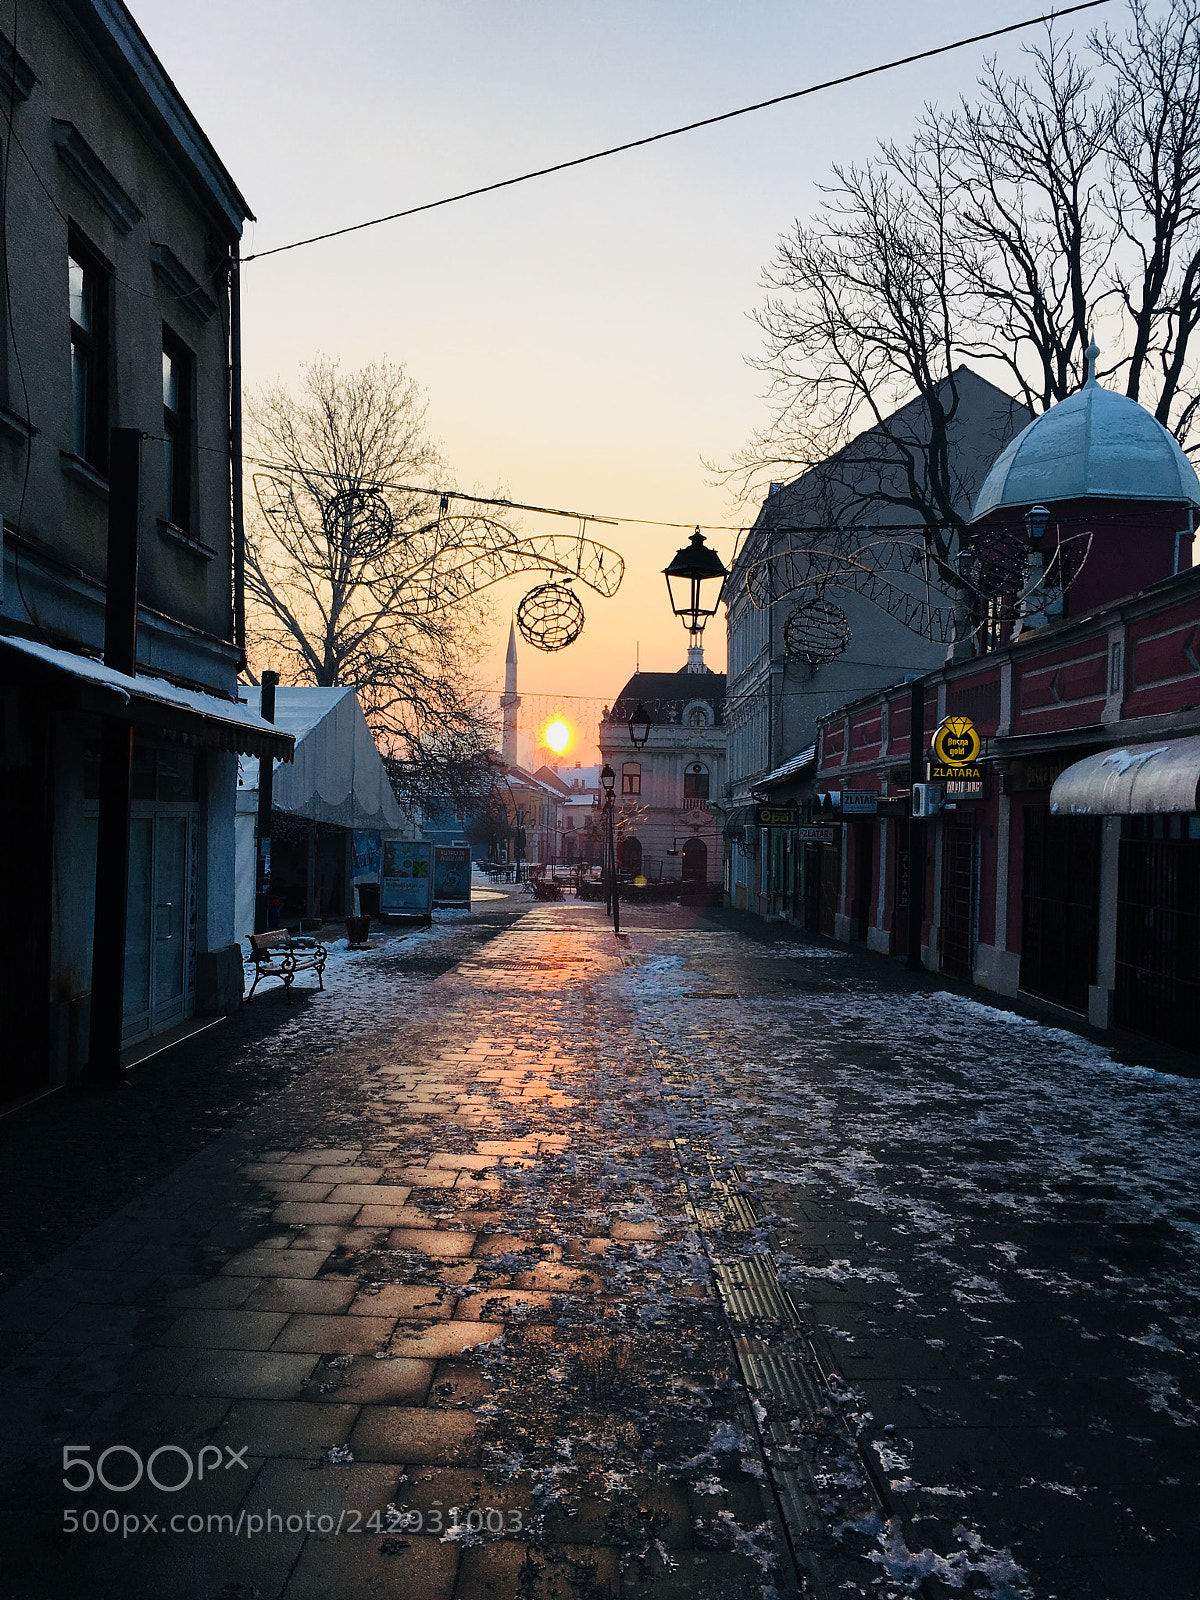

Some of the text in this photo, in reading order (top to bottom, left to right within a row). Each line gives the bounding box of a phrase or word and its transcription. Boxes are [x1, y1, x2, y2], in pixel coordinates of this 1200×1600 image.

[949, 747, 965, 757] gold
[932, 768, 980, 777] ZLATARA
[760, 811, 794, 824] Opal
